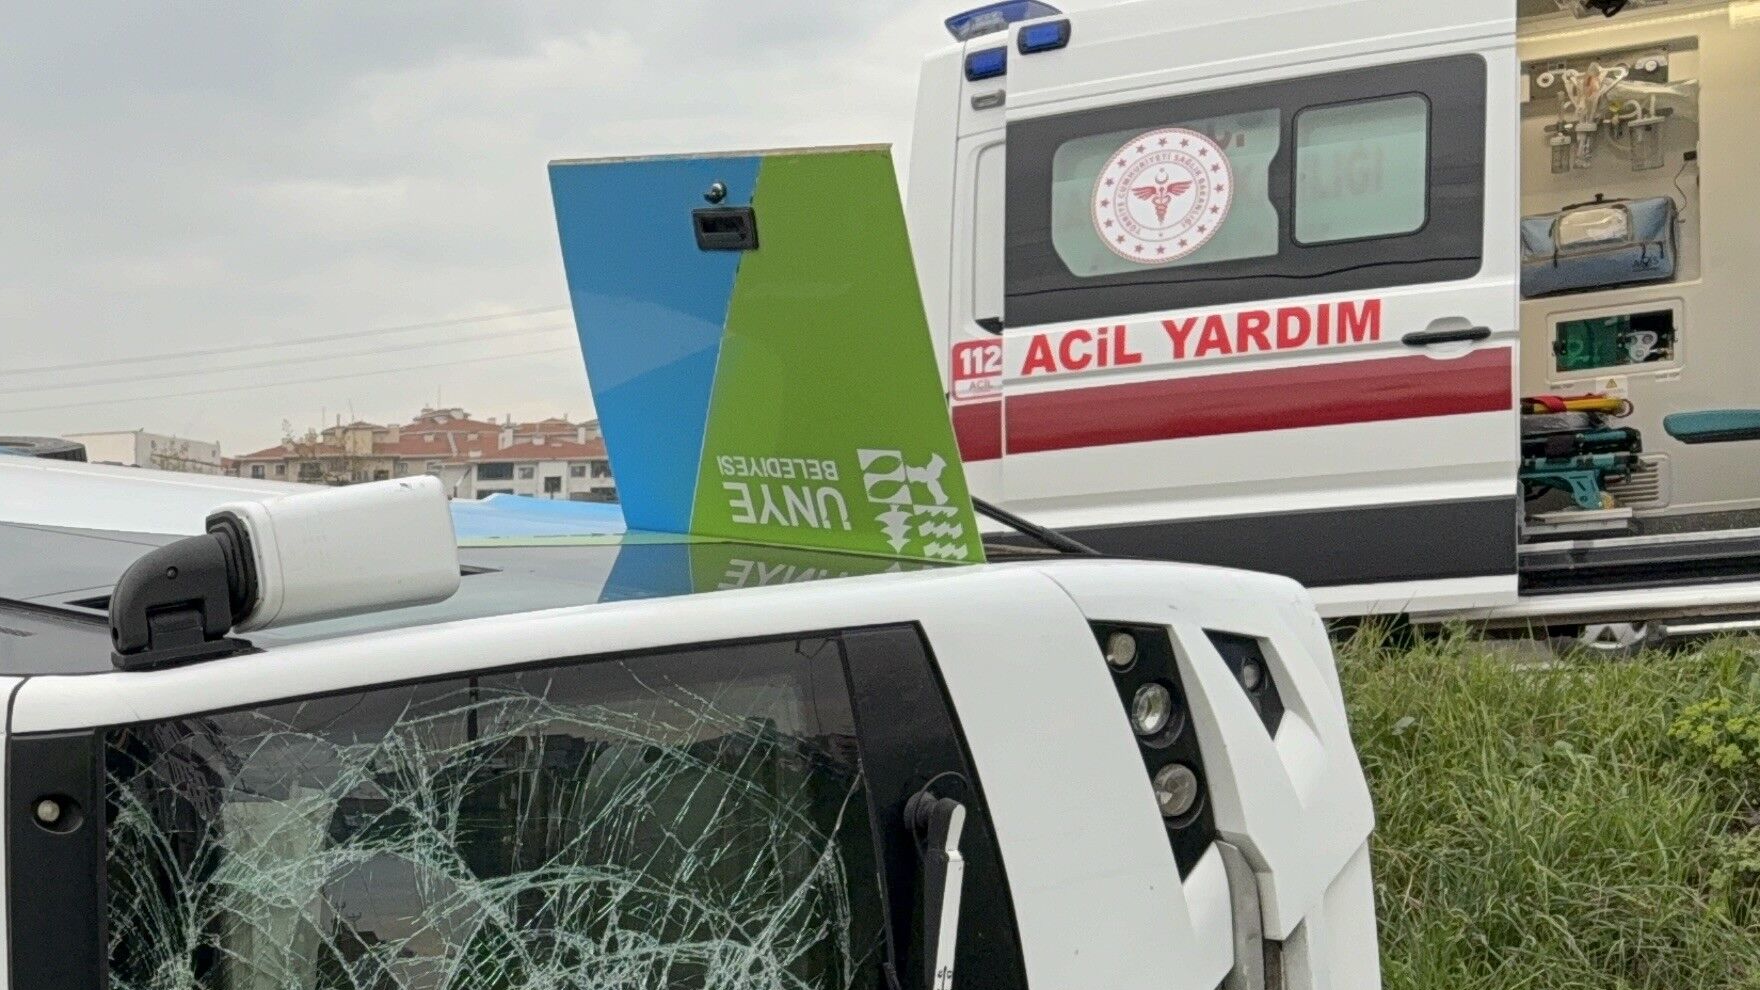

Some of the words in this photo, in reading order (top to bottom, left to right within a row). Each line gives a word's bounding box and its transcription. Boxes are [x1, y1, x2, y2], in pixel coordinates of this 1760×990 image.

[1161, 298, 1381, 359] YARDIM
[959, 344, 1003, 376] 112
[722, 481, 852, 531] ÜNYE
